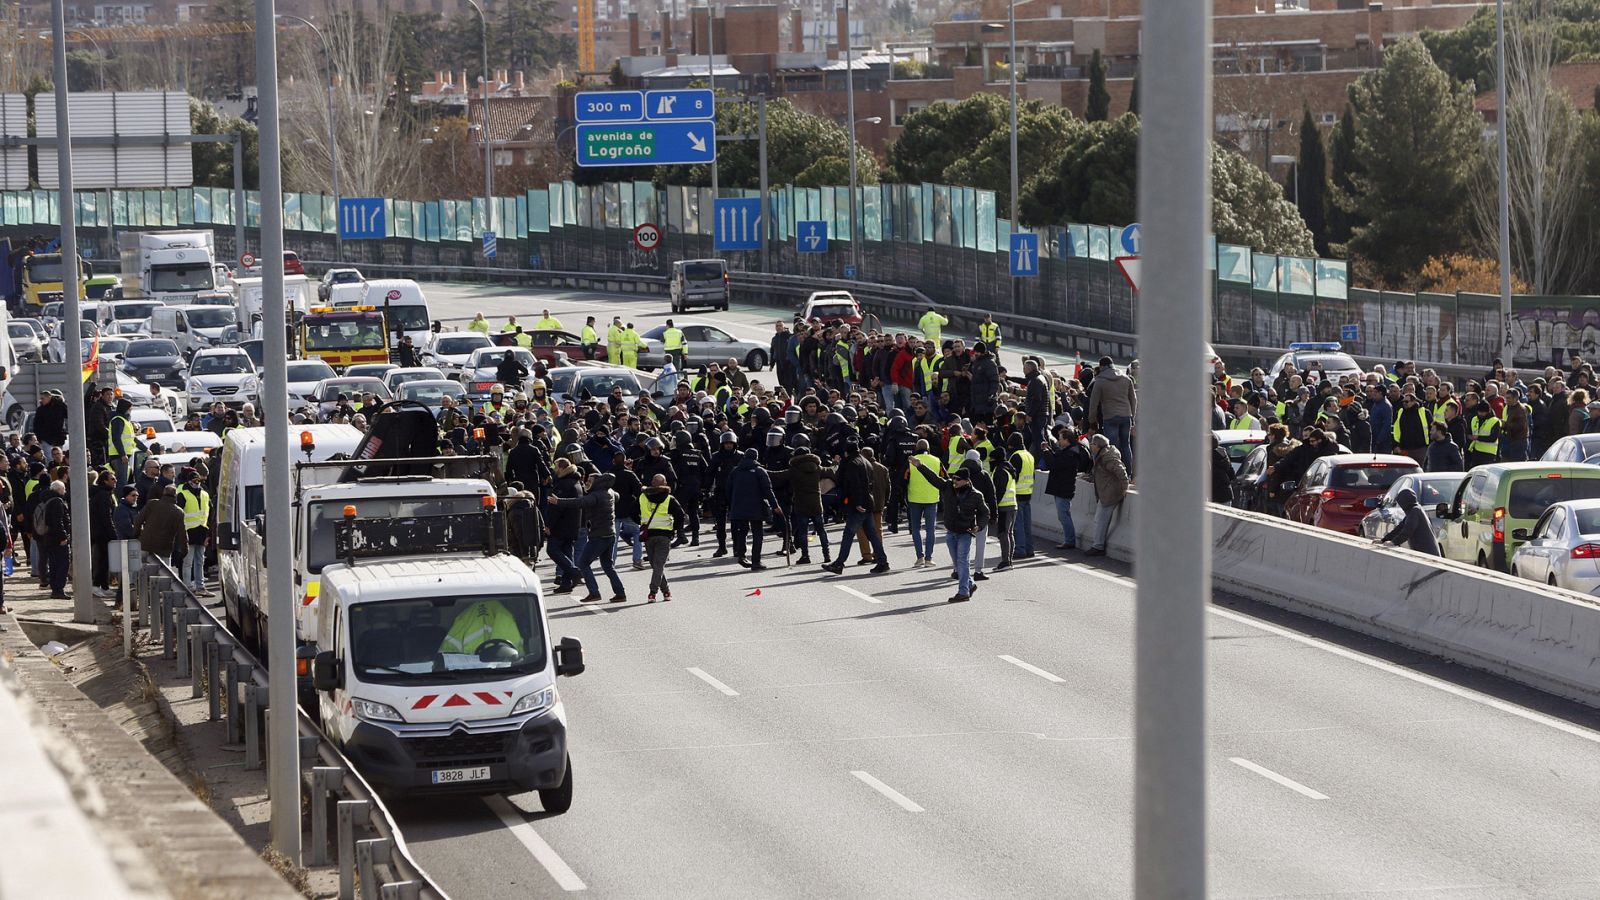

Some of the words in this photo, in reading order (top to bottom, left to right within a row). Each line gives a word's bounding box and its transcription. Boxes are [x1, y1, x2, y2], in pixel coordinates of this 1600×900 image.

[587, 103, 613, 113] 300
[620, 104, 631, 112] m
[695, 100, 703, 109] 8
[588, 132, 633, 141] avenida
[639, 131, 653, 140] de
[589, 144, 652, 159] Logroño
[638, 232, 657, 241] 100
[440, 770, 463, 781] 3828
[469, 768, 486, 779] JLF
